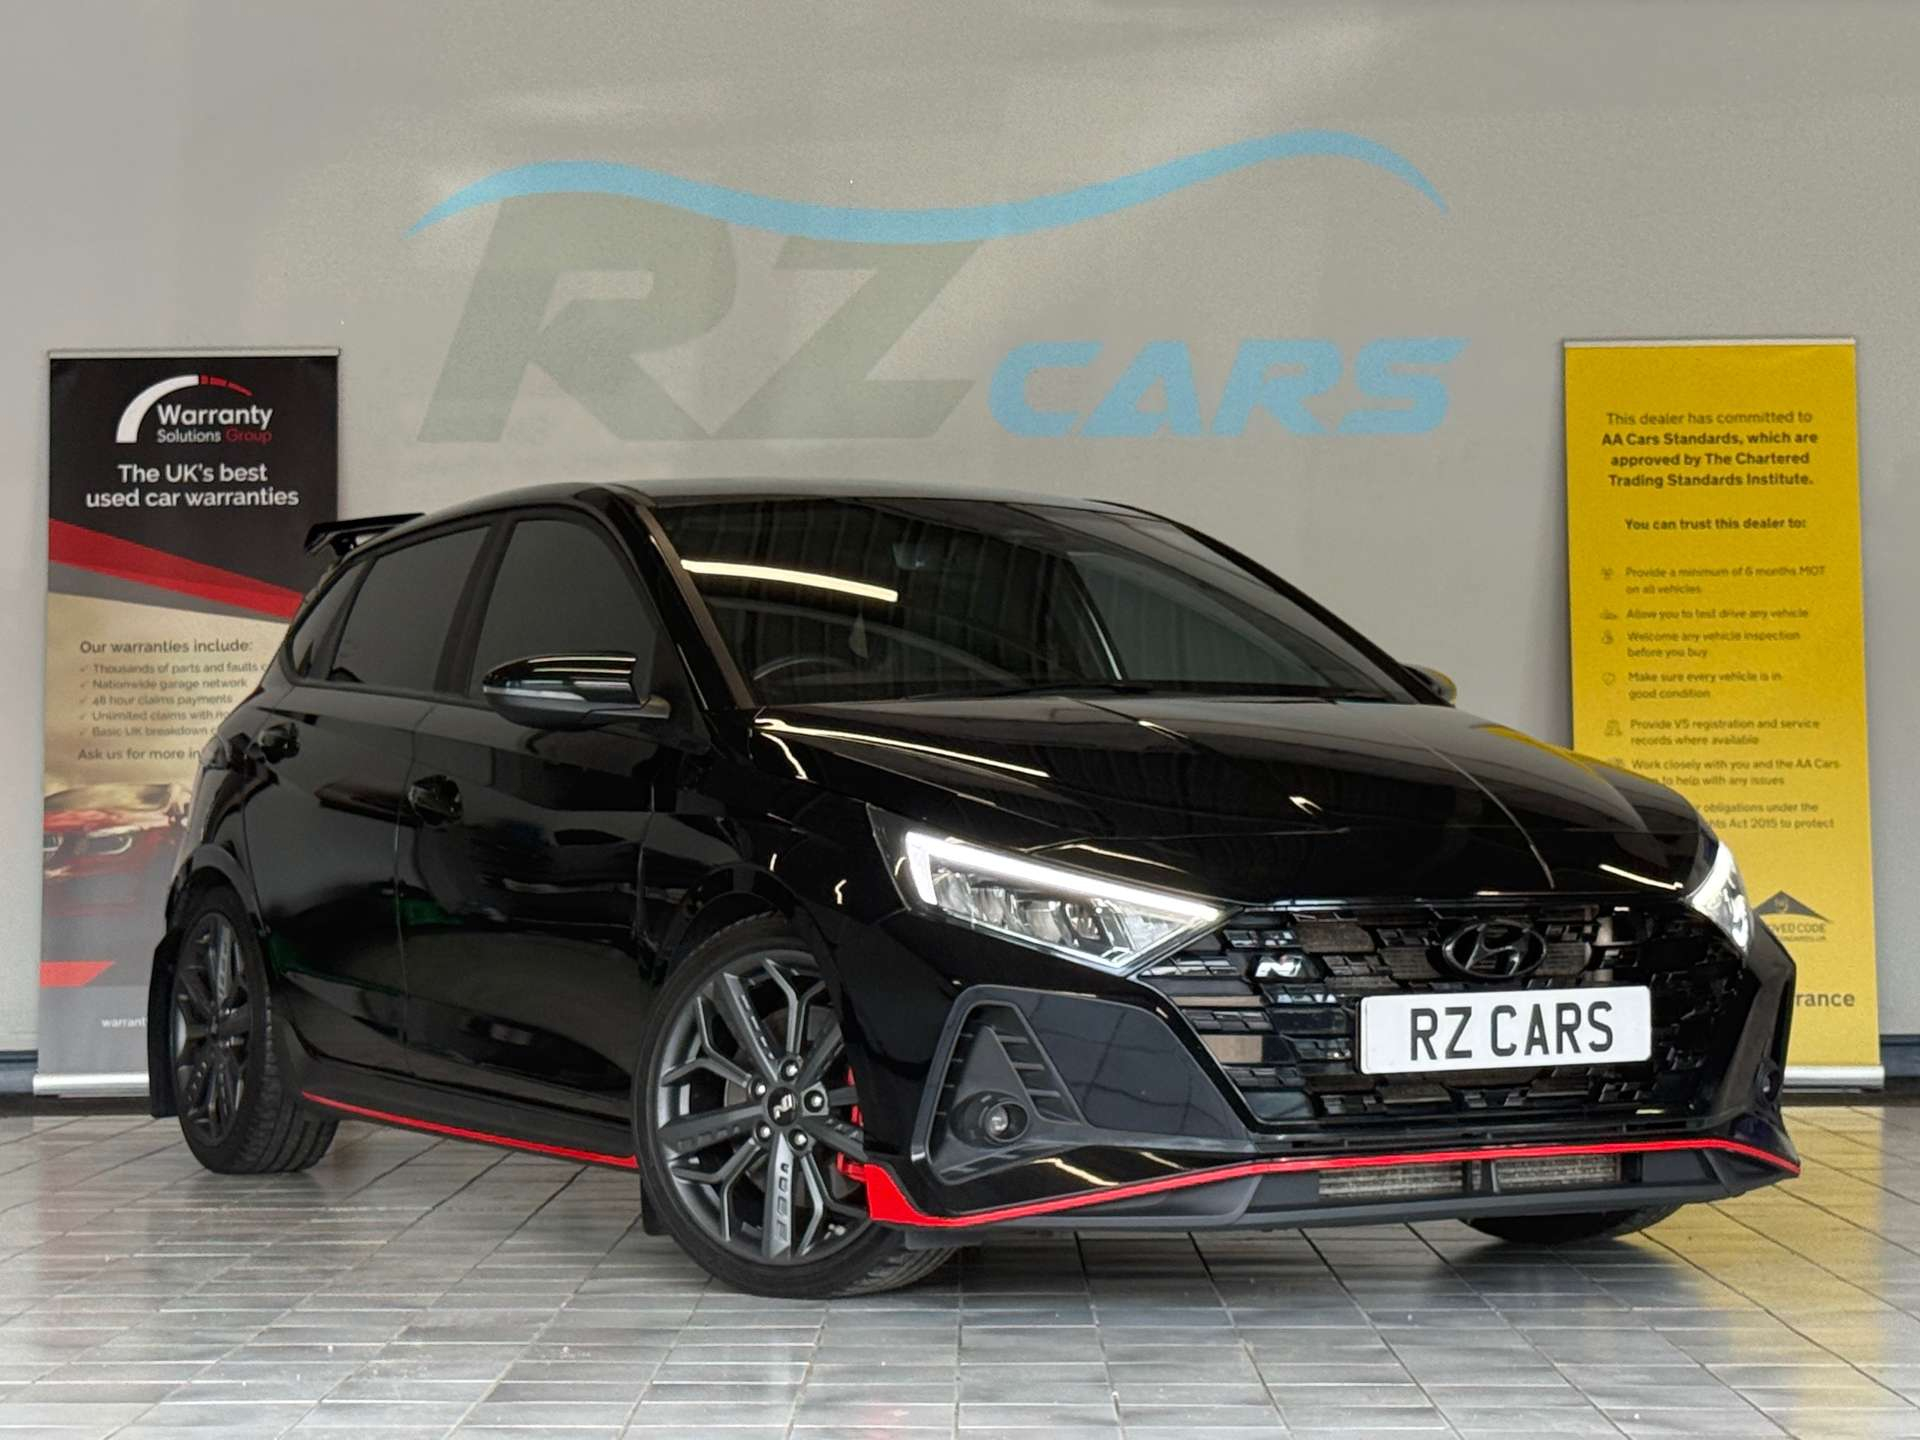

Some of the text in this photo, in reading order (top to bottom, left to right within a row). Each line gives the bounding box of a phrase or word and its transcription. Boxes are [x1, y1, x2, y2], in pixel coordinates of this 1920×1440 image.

[417, 196, 1470, 441] RZ CARS
[157, 404, 273, 430] Warranty
[1607, 411, 1812, 426] This dealer has committed to
[157, 429, 273, 444] Solutions Group
[1601, 431, 1818, 446] AA Cars Standards, which are
[1610, 452, 1809, 468] approved by The Chartered
[117, 463, 267, 483] The UK's best
[1609, 473, 1814, 488] Trading Standards Institute.
[86, 487, 299, 508] used car warranties
[1624, 517, 1806, 530] You can trust this dealer to:
[1625, 567, 1666, 578] Provide
[1678, 566, 1729, 577] minimum
[1732, 566, 1743, 577] of
[1755, 565, 1797, 576] months
[1799, 565, 1825, 576] MOT
[1626, 584, 1700, 594] on all vehicles
[1626, 608, 1808, 620] Allow you to test drive any vehicle
[1627, 630, 1800, 643] Welcome any vehicle inspection
[80, 639, 253, 653] Our warranties include:
[1627, 647, 1707, 660] before you buy
[94, 664, 155, 673] Thousands
[157, 662, 169, 673] of
[172, 664, 200, 675] parts
[203, 663, 224, 673] and
[226, 662, 258, 672] faults
[1628, 671, 1782, 684] Make sure every vehicle is in
[93, 679, 248, 691] Nationwide garage network
[92, 694, 232, 706] 48 hour claims payments
[1628, 688, 1710, 700] good condition
[92, 711, 148, 720] Unlimited
[151, 710, 187, 720] claims
[190, 710, 213, 720] with
[92, 727, 121, 737] Basic
[126, 727, 143, 736] UK
[145, 726, 208, 736] breakdown
[1630, 719, 1671, 729] Provide
[1692, 719, 1754, 731] registration
[1757, 719, 1778, 729] and
[1780, 719, 1820, 729] service
[1630, 734, 1759, 745] records where available
[78, 749, 103, 760] Ask
[106, 751, 122, 760] us
[127, 748, 147, 759] for
[150, 750, 185, 760] more
[1631, 758, 1839, 771] Work closely with you and the AA Cars
[1662, 776, 1673, 785] to
[1676, 776, 1700, 787] help
[1703, 776, 1726, 785] with
[1729, 777, 1748, 787] any
[1750, 776, 1784, 785] issues
[1704, 803, 1764, 814] obligations
[1766, 803, 1797, 813] under
[1800, 803, 1818, 812] the
[1729, 818, 1748, 829] Act
[1780, 818, 1792, 829] to
[1794, 818, 1834, 830] protect
[1410, 1000, 1614, 1061] RZ CARS
